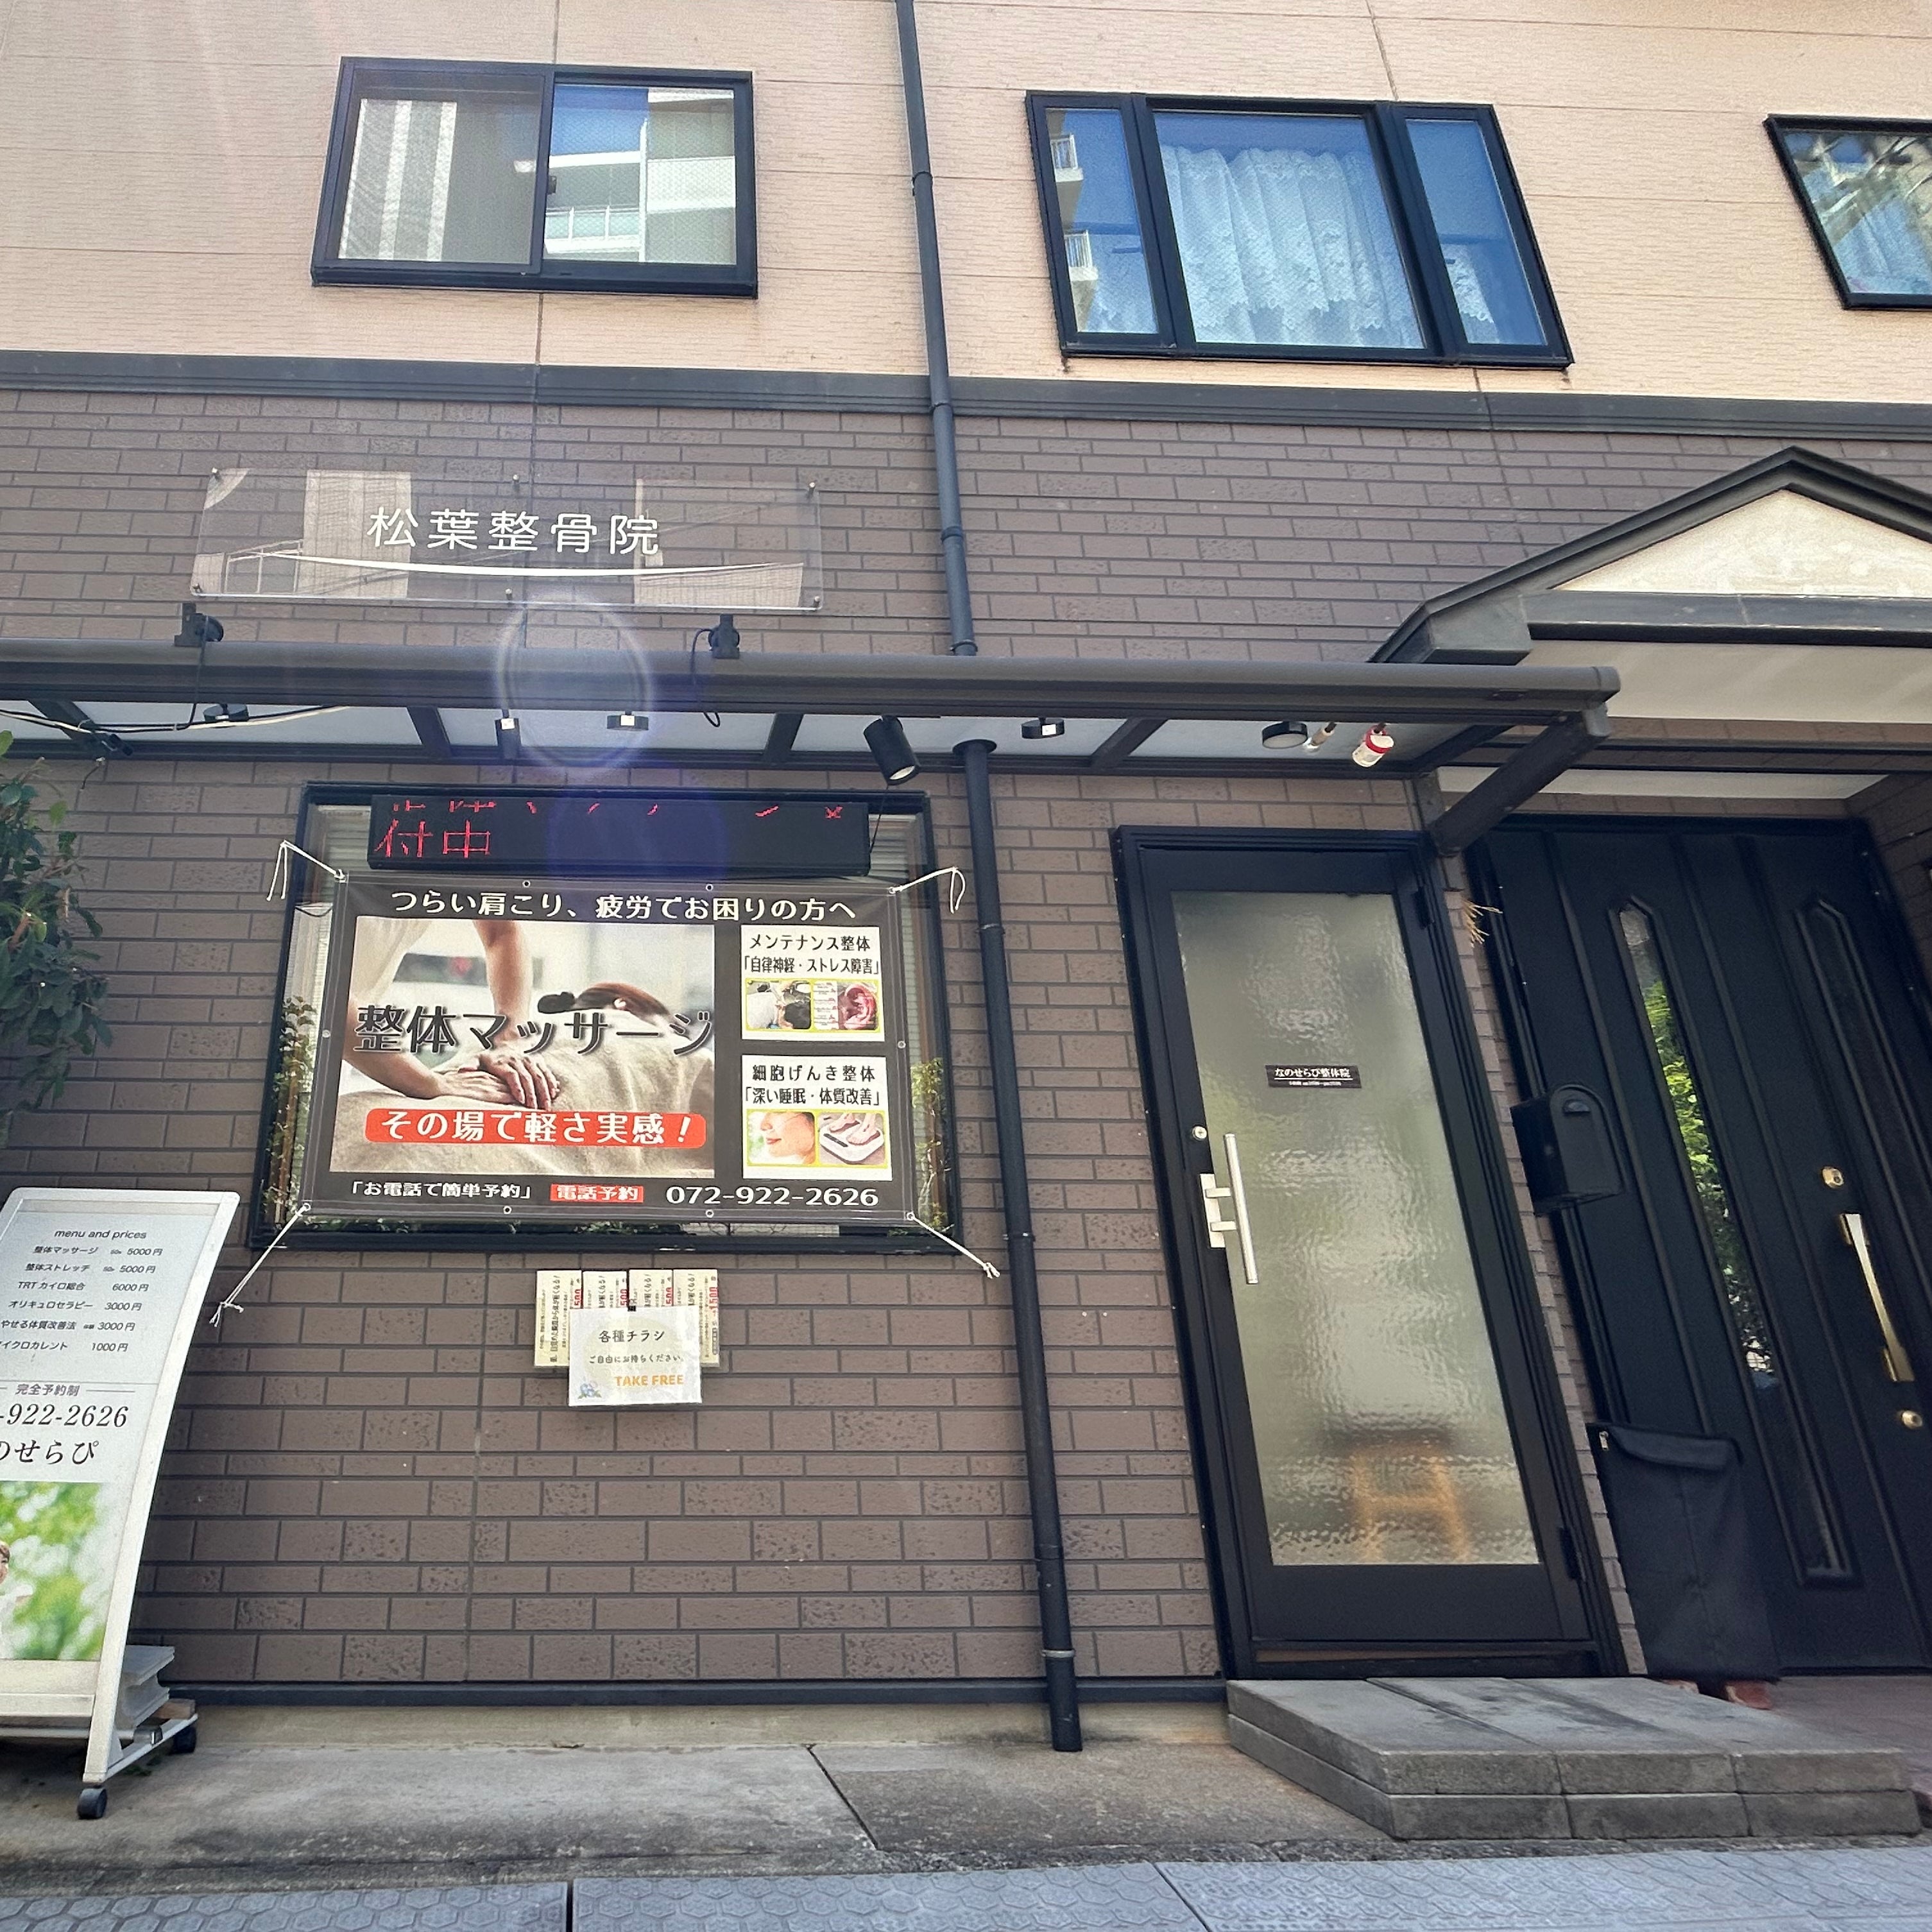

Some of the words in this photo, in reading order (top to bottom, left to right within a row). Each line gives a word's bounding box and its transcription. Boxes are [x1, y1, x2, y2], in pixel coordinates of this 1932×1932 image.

[366, 506, 660, 555] 松葉整骨院
[390, 889, 857, 921] つらい肩こり、疲労でお困りの方へ
[749, 934, 871, 952] メンテナンス整体
[354, 1004, 712, 1056] 整体マッサージ
[752, 1064, 876, 1082] 細胞げんき整体
[381, 1111, 694, 1145] その場で軽さ実感！
[556, 1184, 639, 1201] 電話予約
[666, 1186, 879, 1206] 072-922-2626
[112, 1230, 147, 1240] prices
[33, 1246, 99, 1254] 整体マッサージ
[25, 1263, 90, 1272] 整体ストレッチ
[119, 1265, 156, 1274] 5000円
[112, 1283, 149, 1292] 6000円
[104, 1302, 142, 1311] 3000円
[98, 1322, 135, 1331] 3000円
[599, 1329, 665, 1343] 各種チラシ
[0, 1341, 68, 1351] イクロカレント
[92, 1342, 128, 1352] 1000円
[615, 1375, 648, 1387] TAKE
[652, 1374, 684, 1386] FREE
[15, 1383, 81, 1396] 完全予約制
